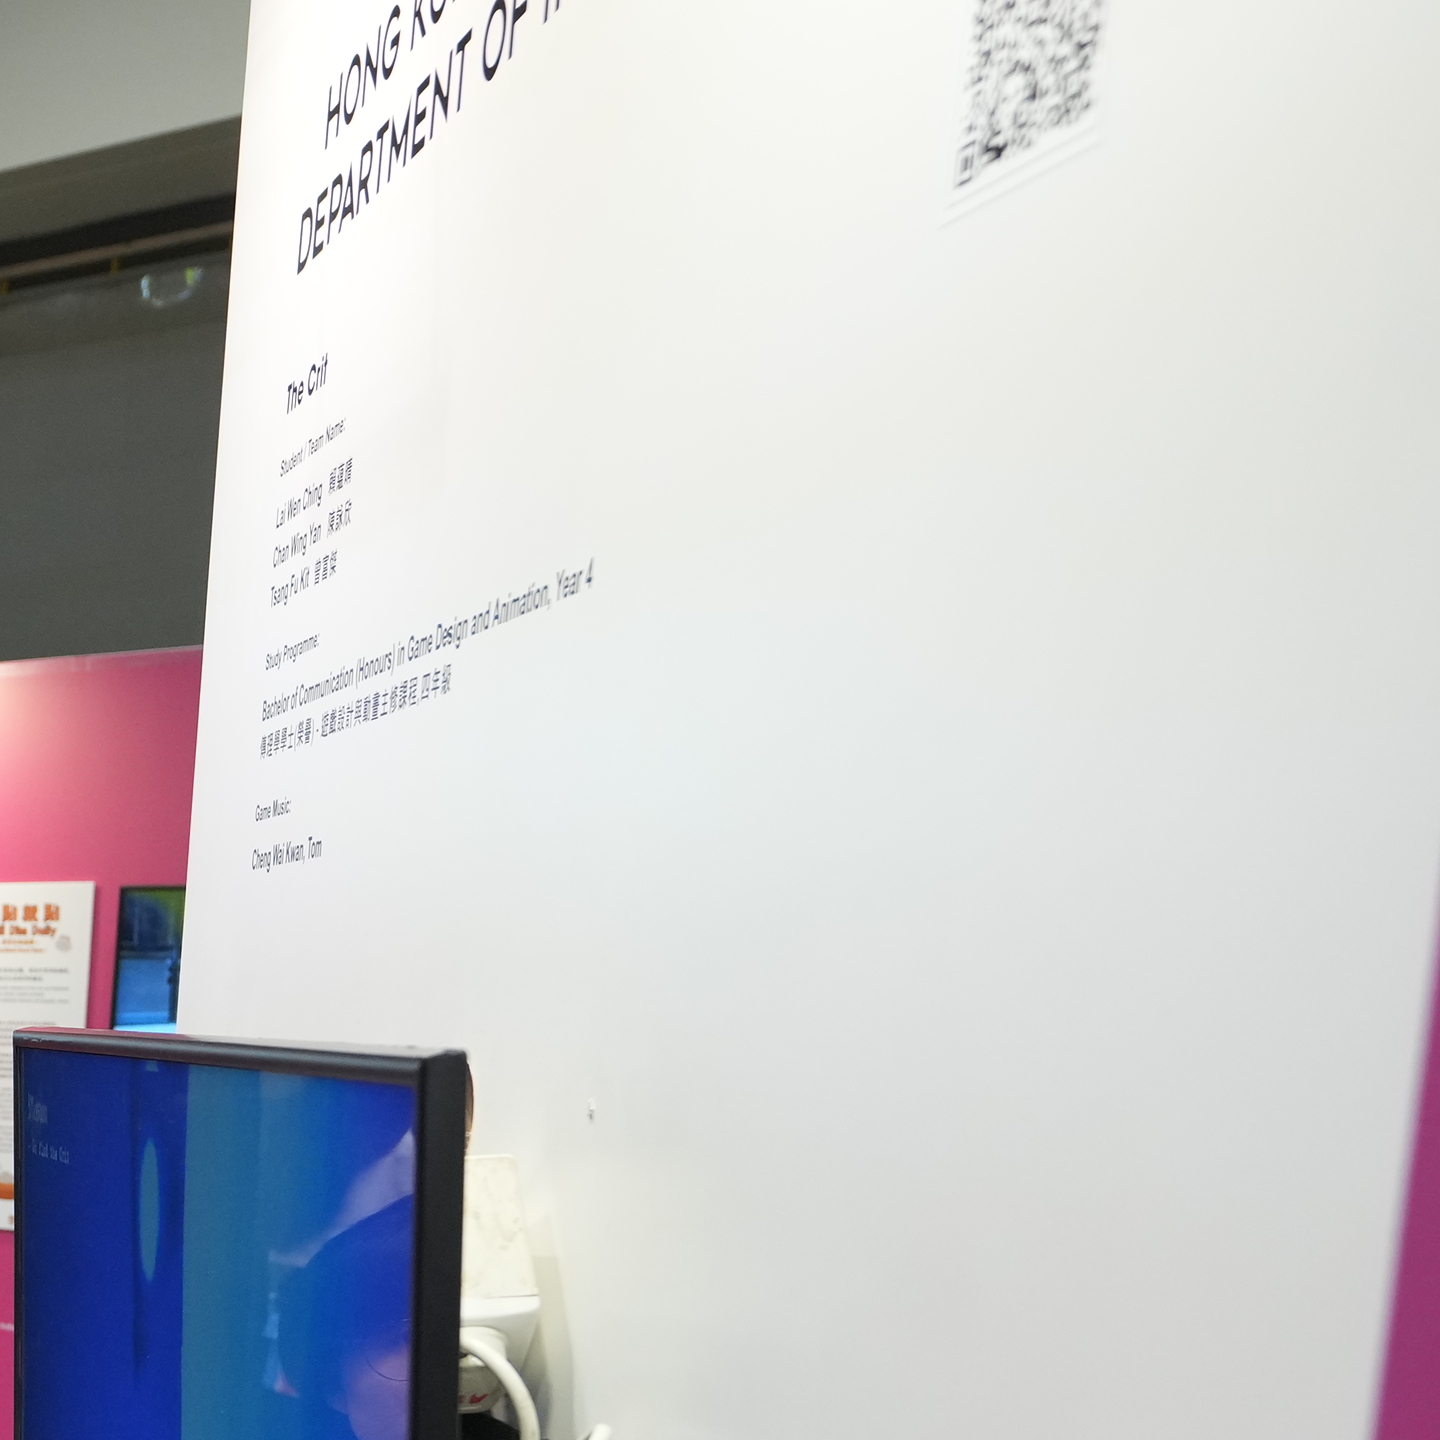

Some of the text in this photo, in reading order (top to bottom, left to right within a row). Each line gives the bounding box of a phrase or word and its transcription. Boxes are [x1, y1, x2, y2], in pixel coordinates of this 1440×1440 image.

[324, 4, 401, 151] HONG
[297, 27, 473, 276] DEPARTMENT
[286, 352, 328, 415] The Crit
[280, 445, 304, 478] Student
[308, 434, 324, 457] Team
[325, 417, 346, 444] Name:
[276, 483, 323, 529] Lai Wen Ching
[272, 522, 322, 568] Chan Wing Yan
[270, 566, 310, 608] Tsang Fu Kit
[261, 556, 595, 722] Bachelor of Communication (Honours) in Game Design and Animation, Year 4
[265, 633, 320, 671] Study Programme:
[254, 797, 291, 822] Game Music:
[251, 836, 322, 873] Cheng Wai Kwan, Tom
